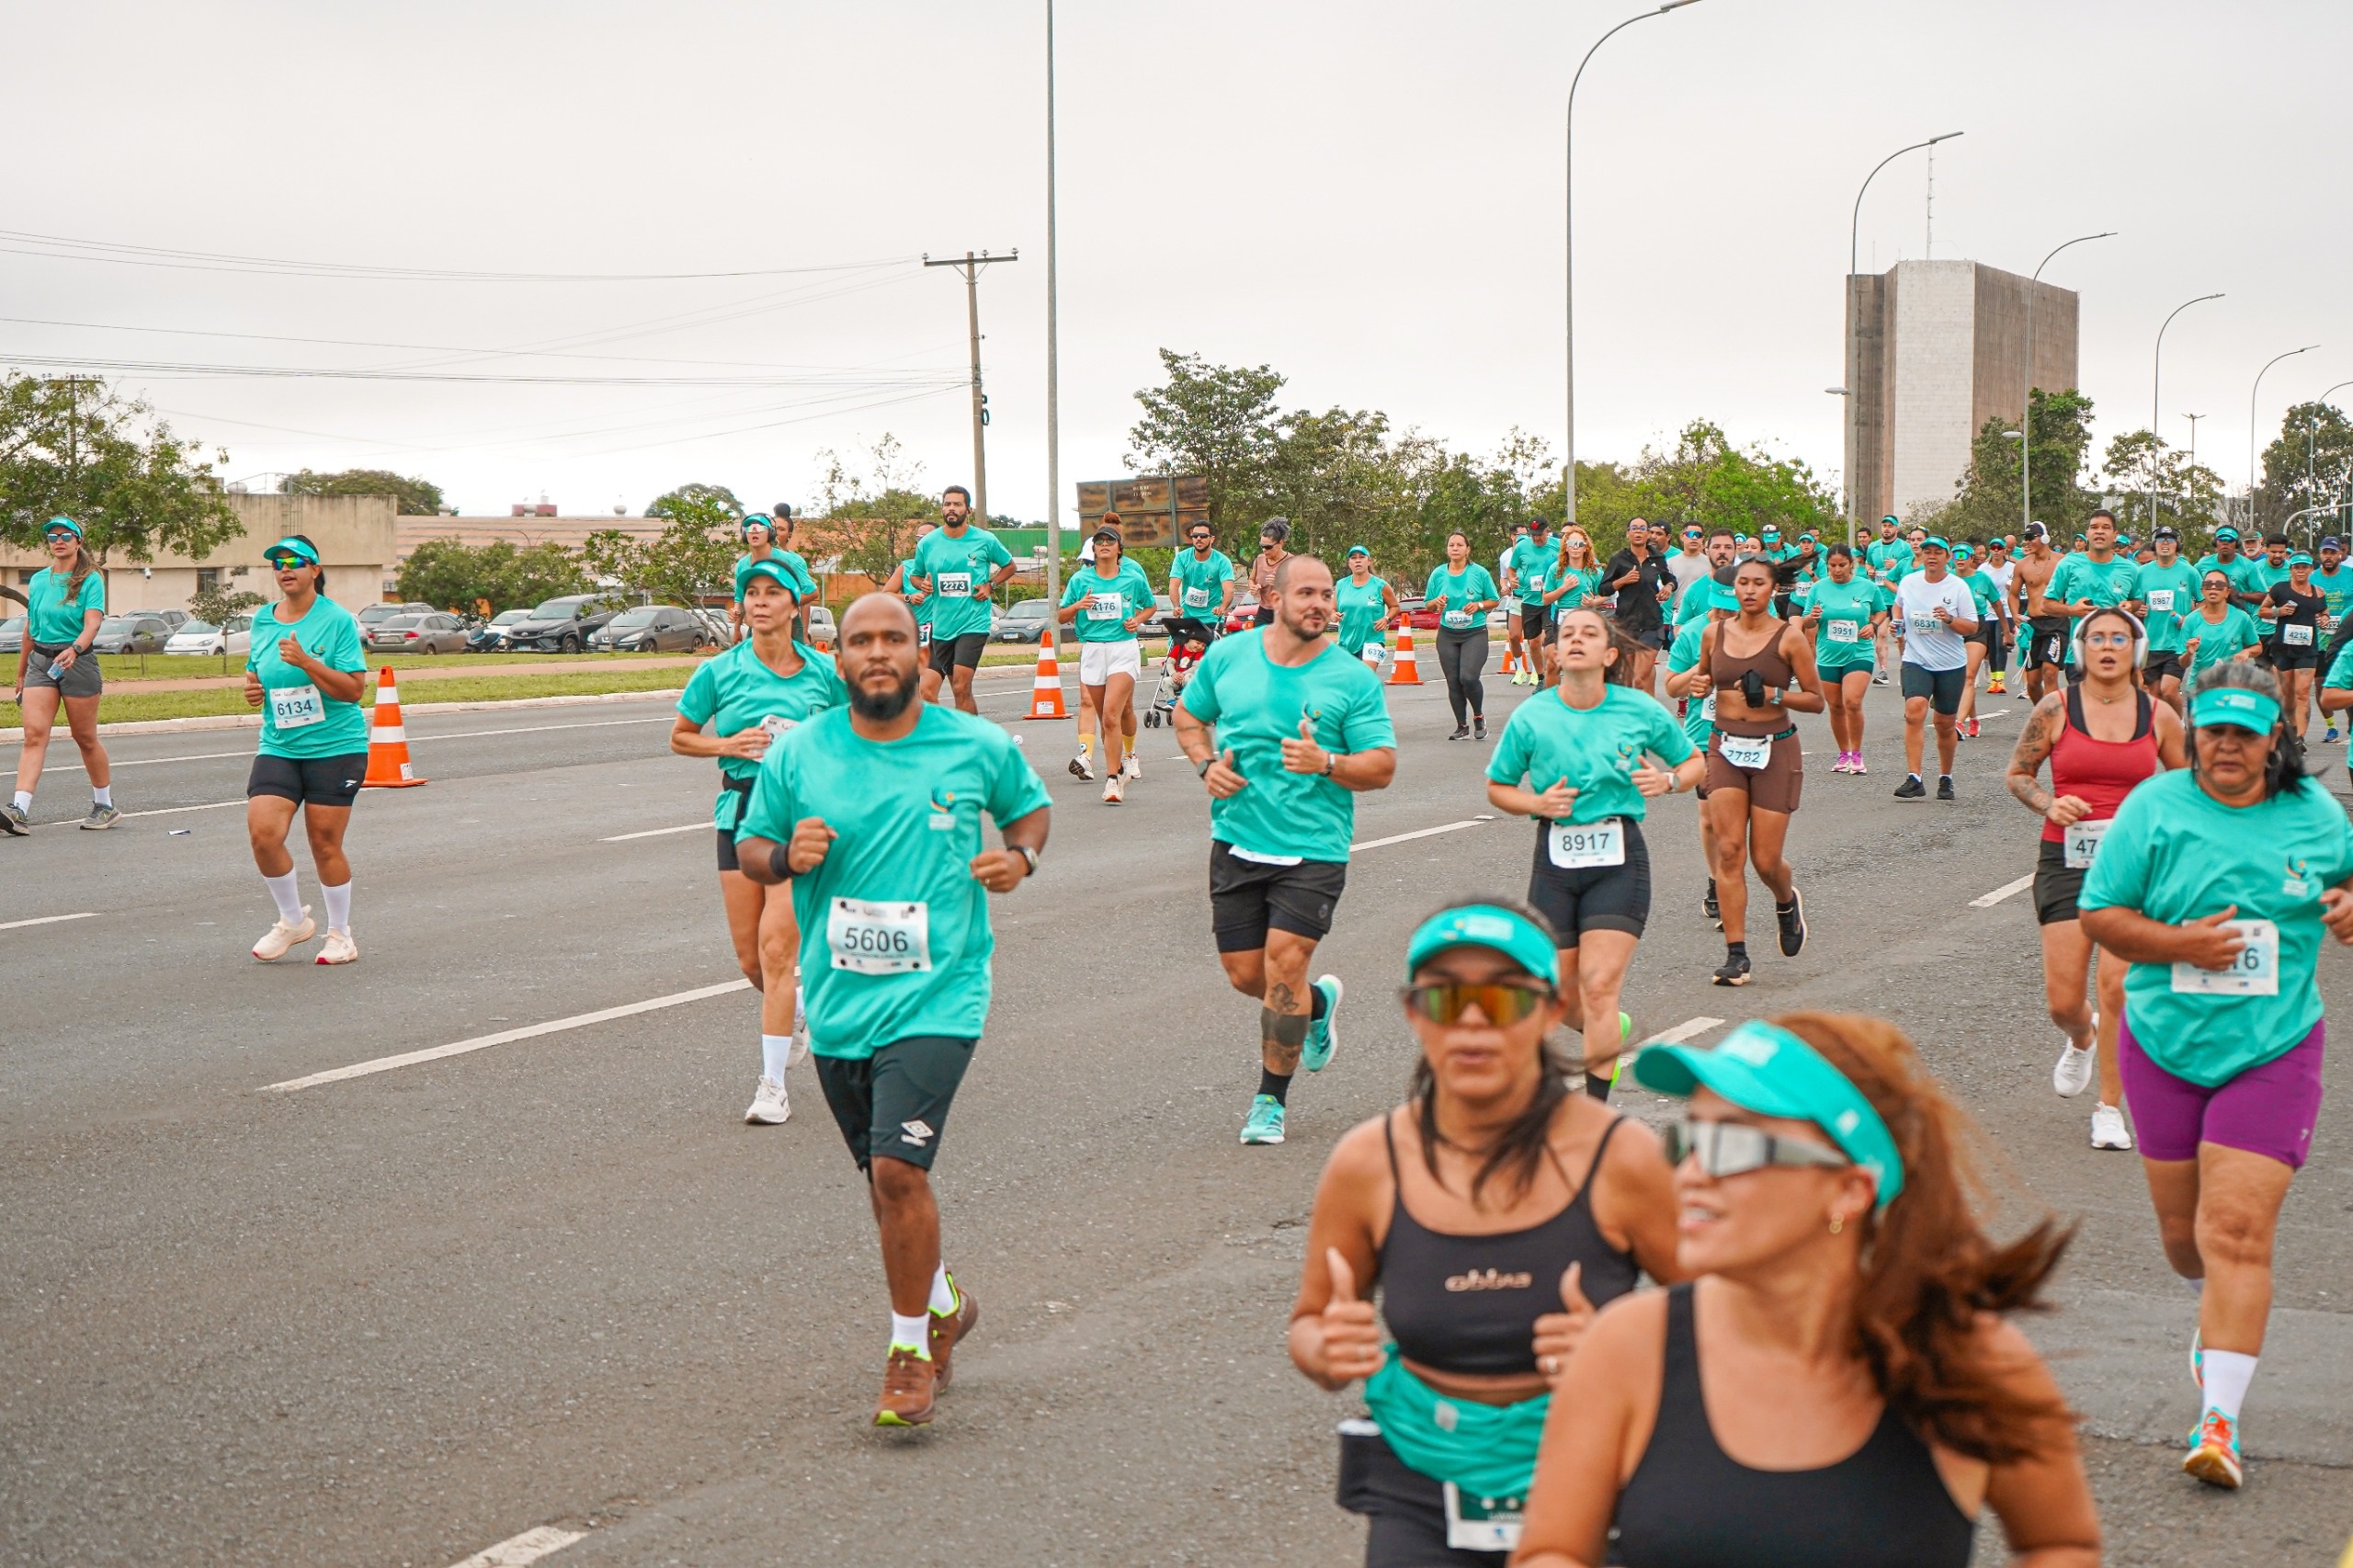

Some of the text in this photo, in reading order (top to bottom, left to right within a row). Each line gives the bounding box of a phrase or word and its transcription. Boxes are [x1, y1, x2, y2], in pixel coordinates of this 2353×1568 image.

[943, 582, 965, 590] 2273
[1092, 603, 1115, 611] 4176
[1915, 619, 1936, 628] 6831
[1833, 627, 1852, 635] 3951
[278, 699, 313, 715] 6134
[1563, 833, 1609, 851] 8917
[2076, 839, 2103, 854] 47
[845, 926, 908, 952] 5606
